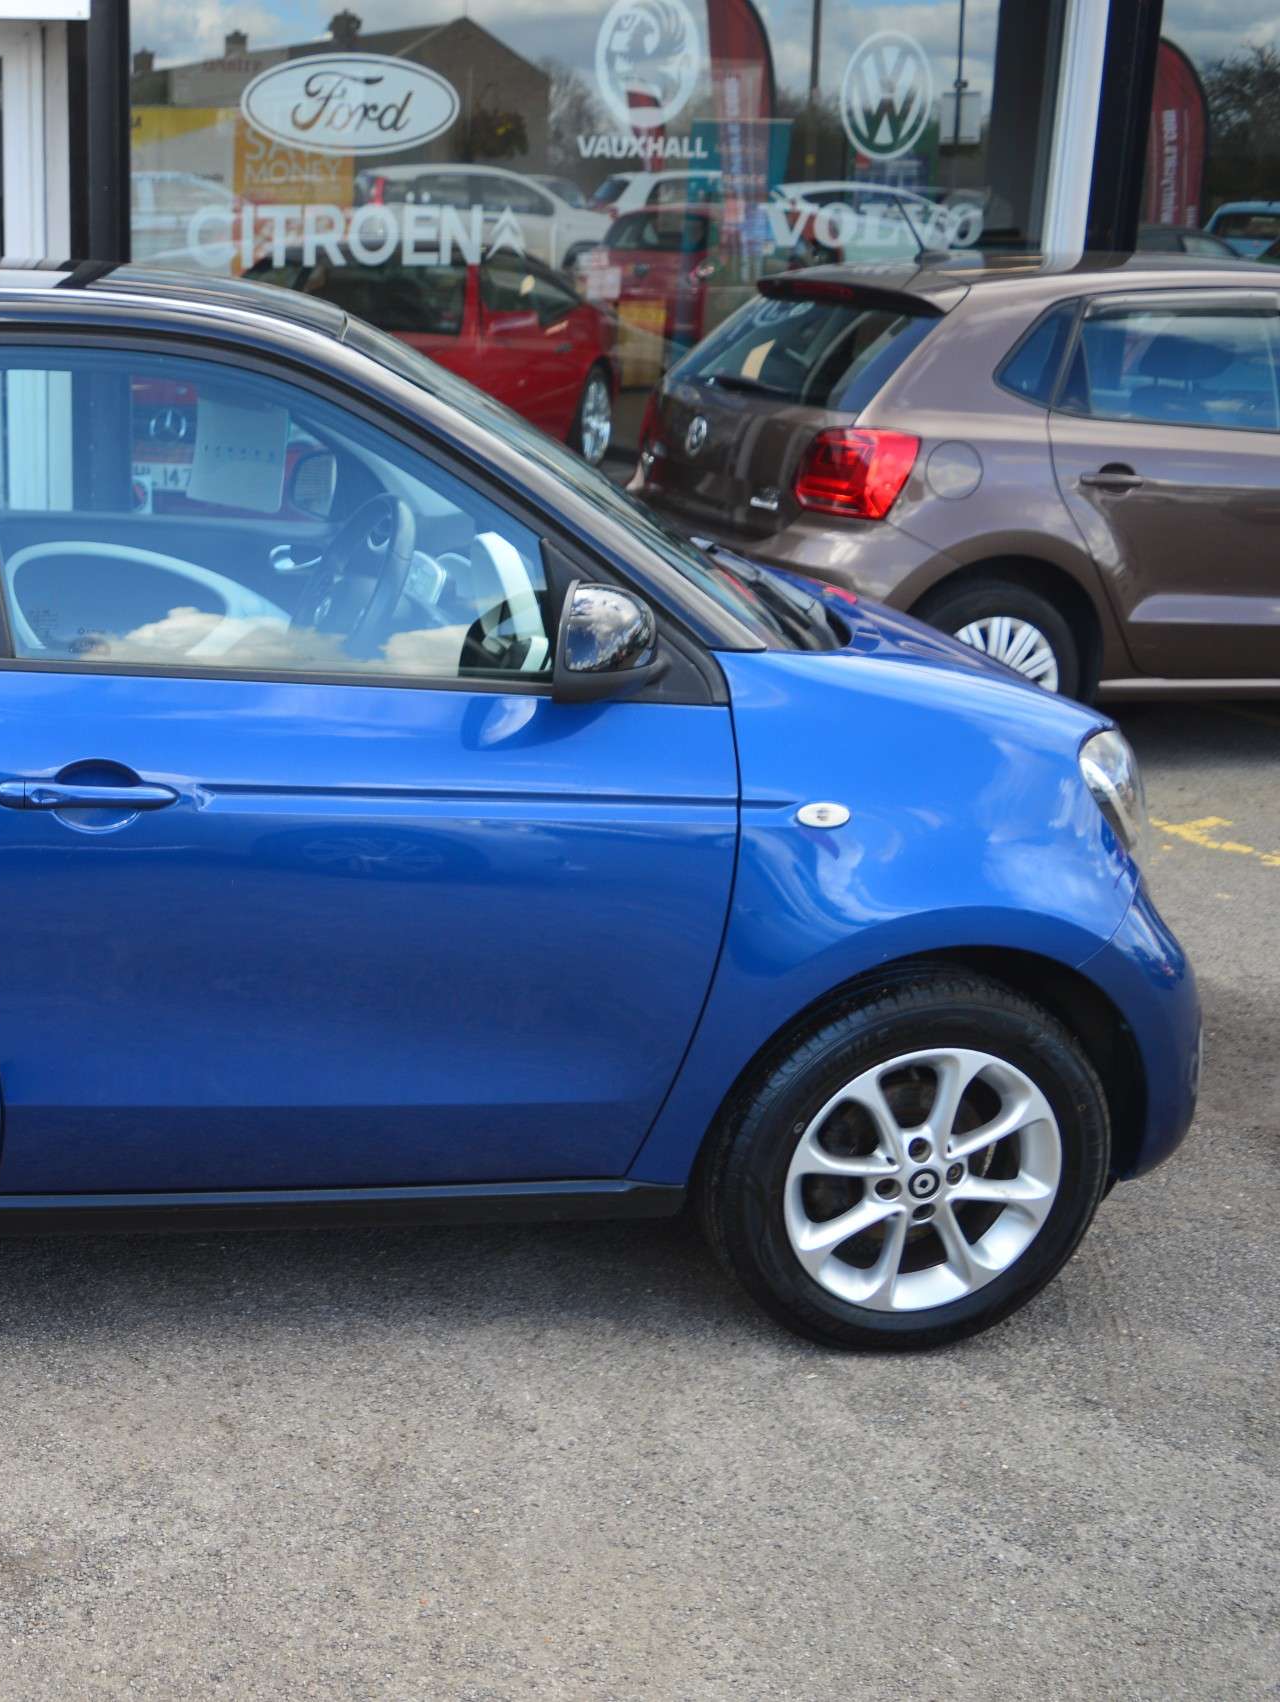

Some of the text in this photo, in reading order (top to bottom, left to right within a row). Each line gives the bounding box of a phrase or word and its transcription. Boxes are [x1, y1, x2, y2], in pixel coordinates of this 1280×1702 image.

[291, 71, 414, 133] Ford
[577, 134, 708, 160] VAUXHALL
[244, 160, 343, 184] MONEY
[188, 191, 481, 268] CITROËN
[763, 203, 984, 250] VOLVO
